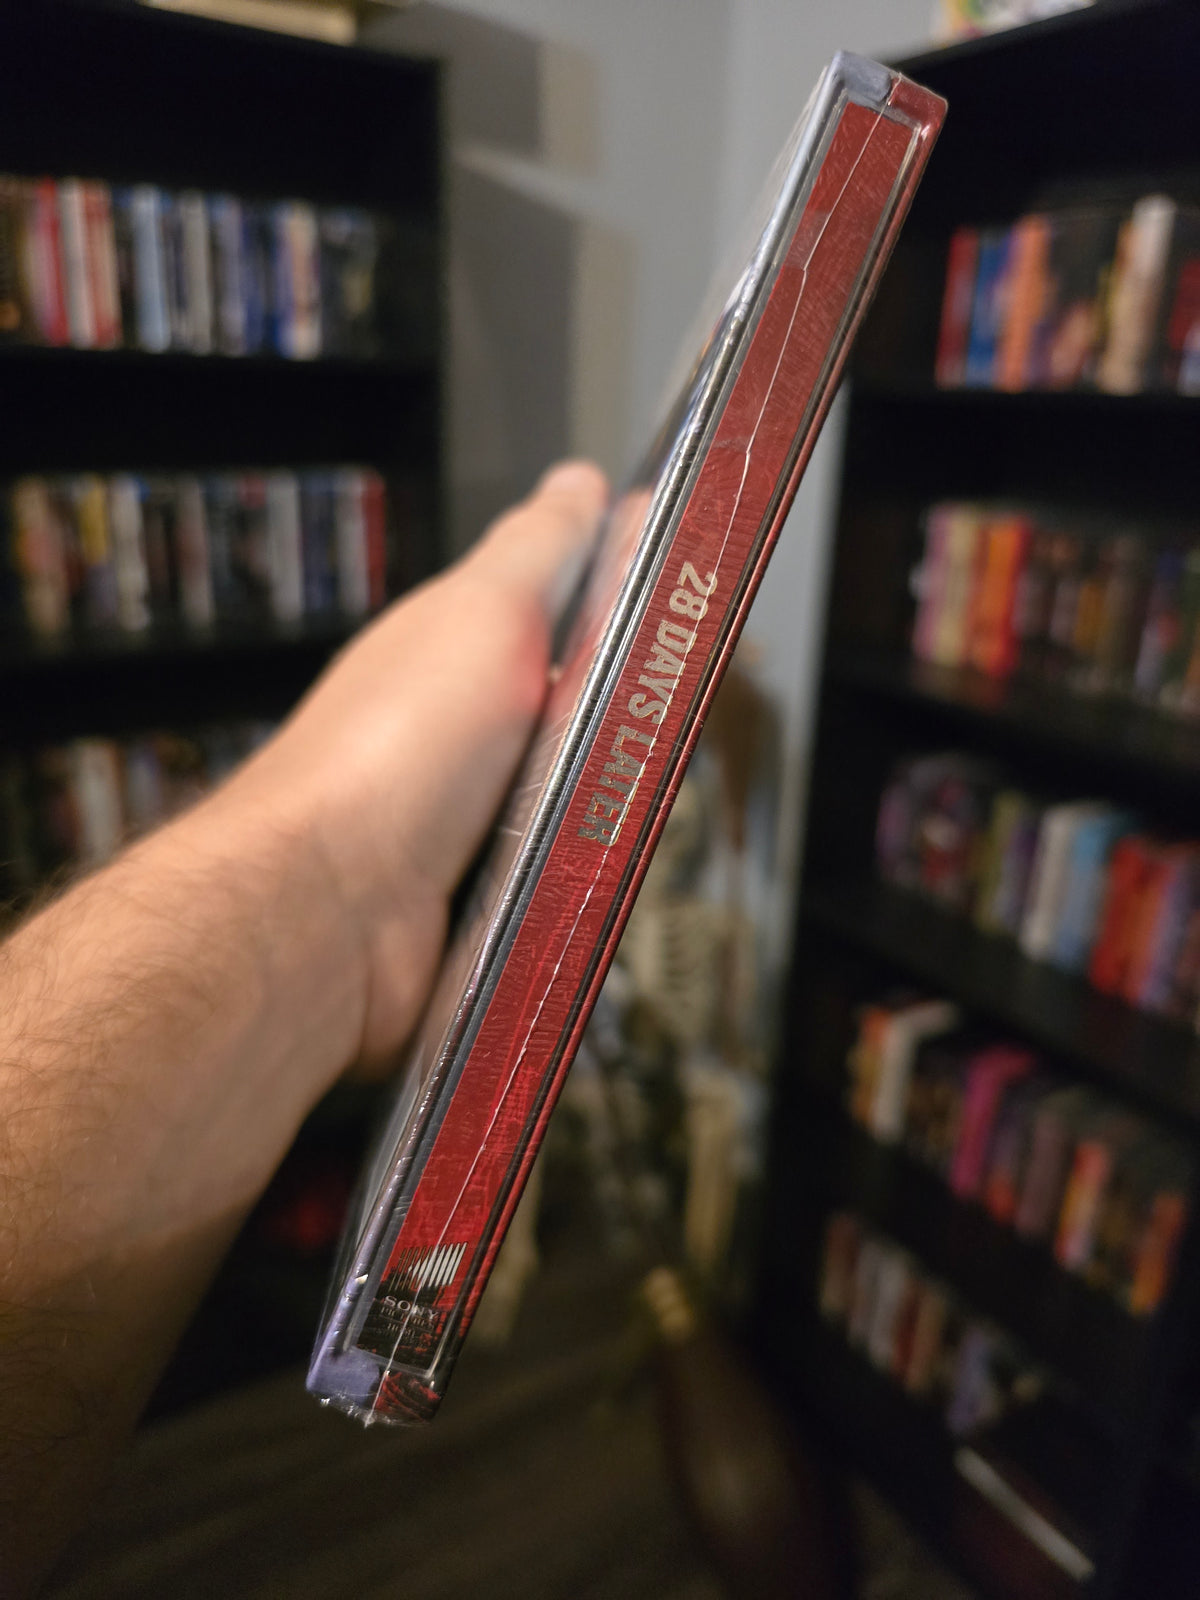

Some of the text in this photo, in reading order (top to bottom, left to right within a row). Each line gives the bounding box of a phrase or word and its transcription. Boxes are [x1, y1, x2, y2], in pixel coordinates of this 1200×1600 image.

[577, 561, 718, 847] 28 DAYS LATER
[384, 1295, 438, 1320] SONY
